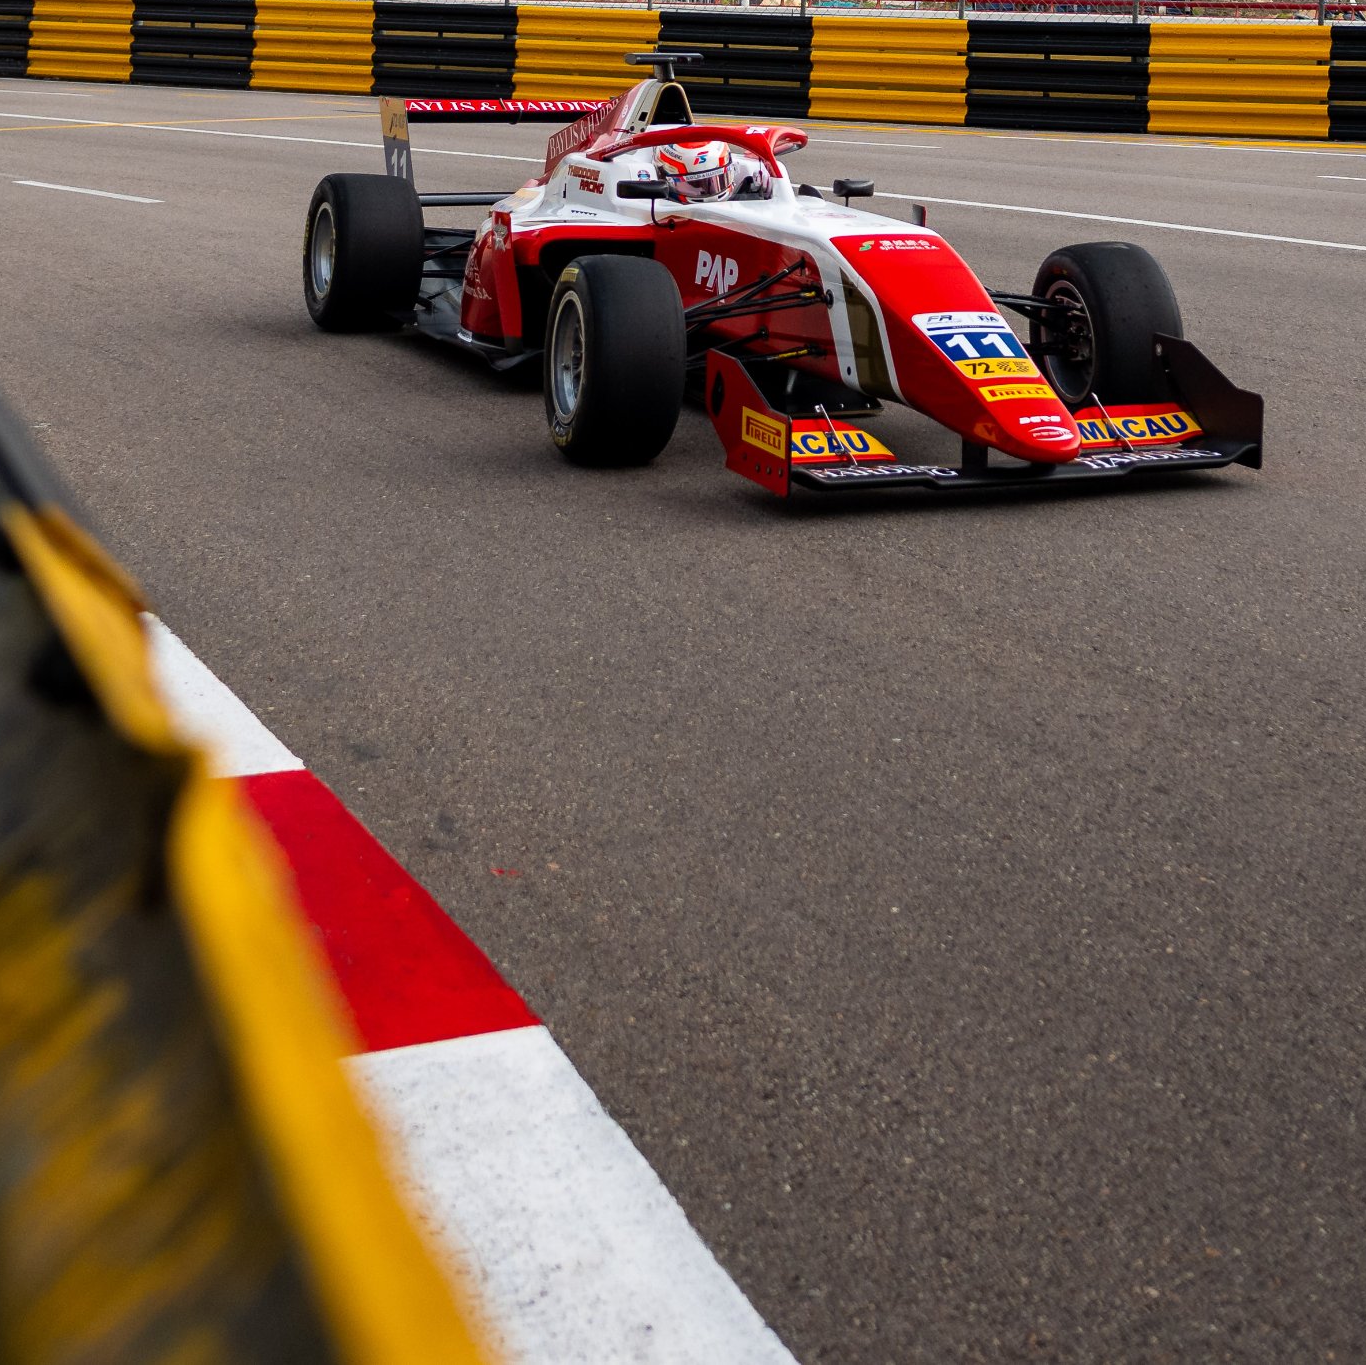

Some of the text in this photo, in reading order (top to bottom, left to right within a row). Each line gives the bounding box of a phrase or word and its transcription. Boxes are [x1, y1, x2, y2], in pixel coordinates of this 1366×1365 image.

[405, 101, 479, 112] AYLIS
[481, 101, 497, 112] &
[549, 122, 579, 160] BAYLIS
[580, 119, 588, 142] &
[392, 148, 407, 179] 11
[695, 249, 739, 304] PAP
[945, 334, 1015, 358] 11
[964, 362, 995, 375] 72
[987, 386, 1048, 398] PIRELLI
[745, 415, 782, 450] PIRELLI
[1078, 413, 1189, 441] MACAU
[792, 433, 870, 455] ACAU
